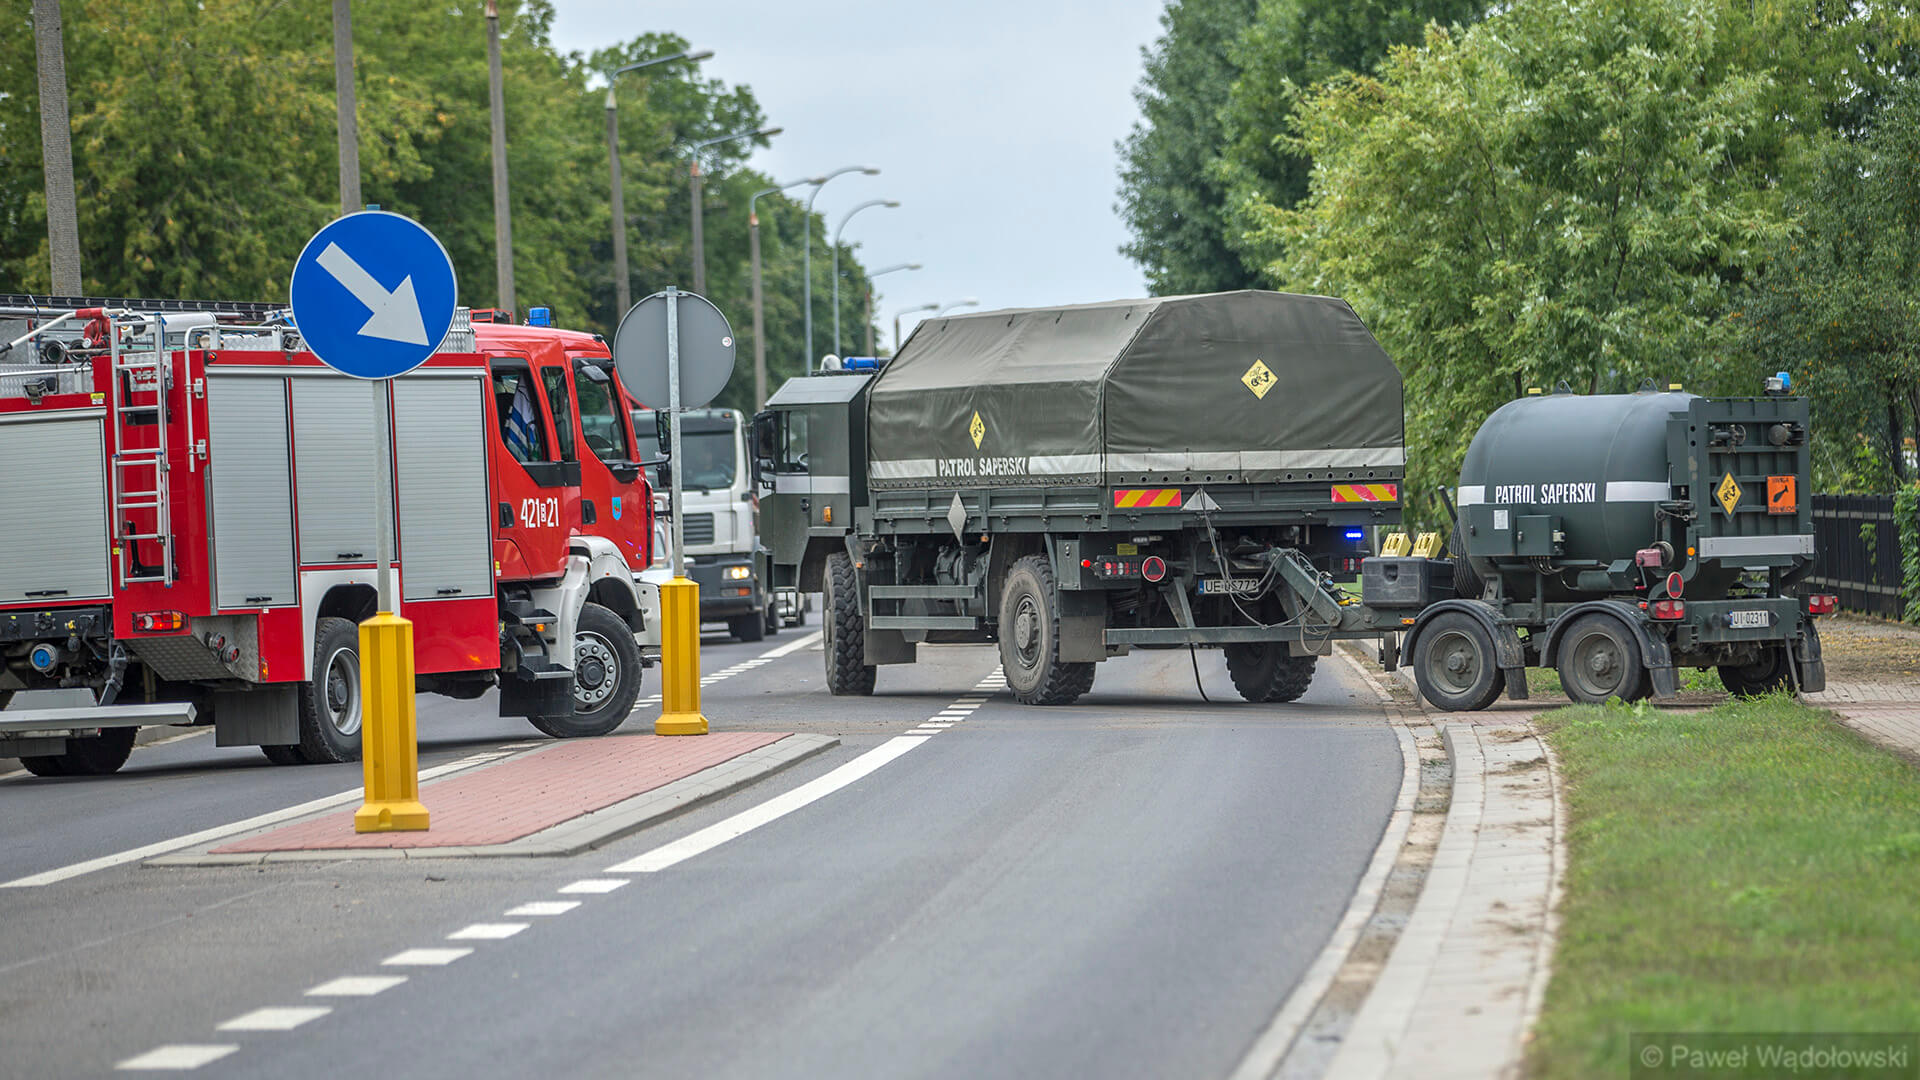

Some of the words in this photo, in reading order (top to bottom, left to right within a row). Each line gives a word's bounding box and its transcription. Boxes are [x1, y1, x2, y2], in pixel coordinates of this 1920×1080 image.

[939, 459, 977, 477] PATROL
[979, 457, 1026, 477] SAPERSKI
[1495, 485, 1537, 504] PATROL
[1541, 483, 1596, 504] SAPERSKI
[1205, 580, 1221, 593] UE
[1733, 612, 1744, 625] UI
[1746, 611, 1768, 625] 02311
